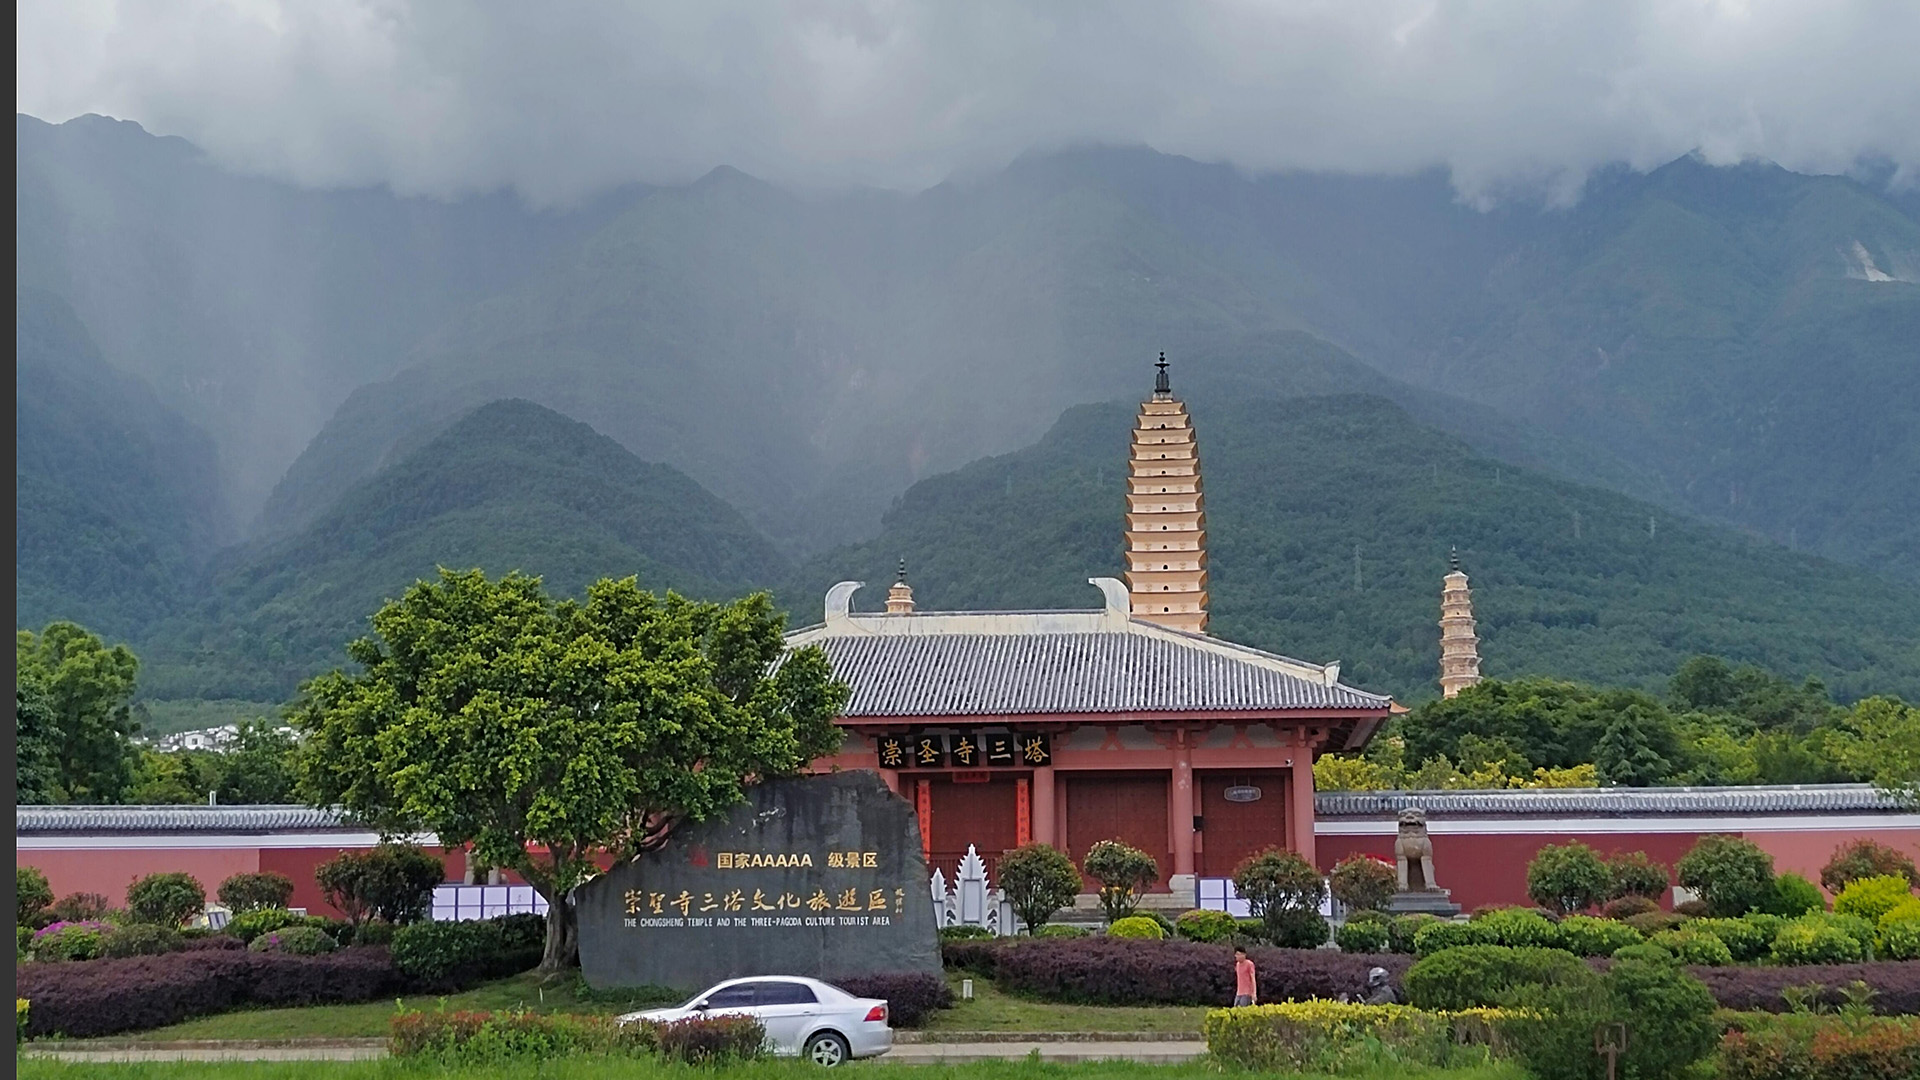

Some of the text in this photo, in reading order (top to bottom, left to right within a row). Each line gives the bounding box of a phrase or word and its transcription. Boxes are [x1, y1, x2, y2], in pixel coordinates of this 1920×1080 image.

[881, 736, 1050, 766] 崇圣寺三塔
[717, 852, 878, 869] 国家AAAAA 级景区
[624, 916, 891, 927] THE CHONGSHENG TEMPLE AND THE THREE-PAGODA CULTURE TOURIST AREA
